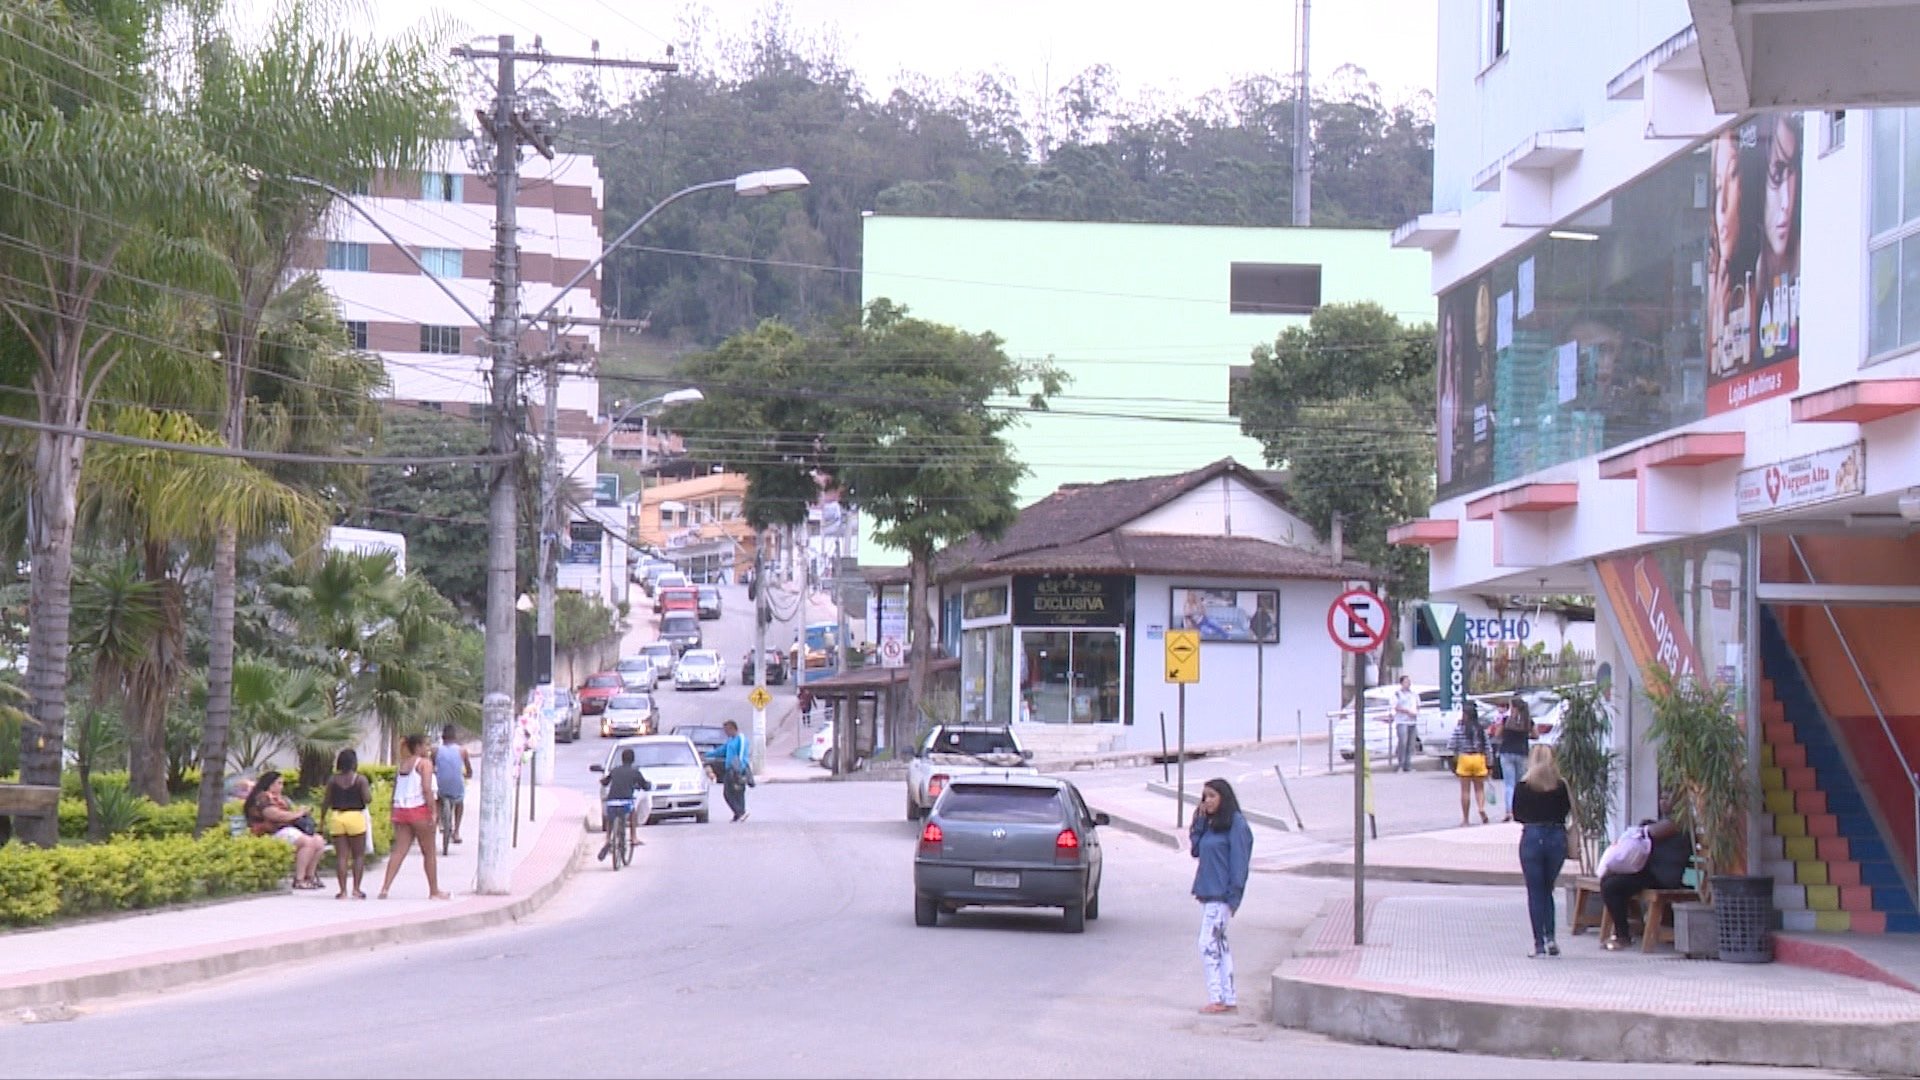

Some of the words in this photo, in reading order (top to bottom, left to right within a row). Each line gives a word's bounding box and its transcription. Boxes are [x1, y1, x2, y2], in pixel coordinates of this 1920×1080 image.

[1781, 473, 1811, 492] Vargem
[1812, 466, 1830, 482] Alta
[1034, 597, 1104, 610] EXCLUSIVA
[1450, 644, 1463, 711] SICOOB
